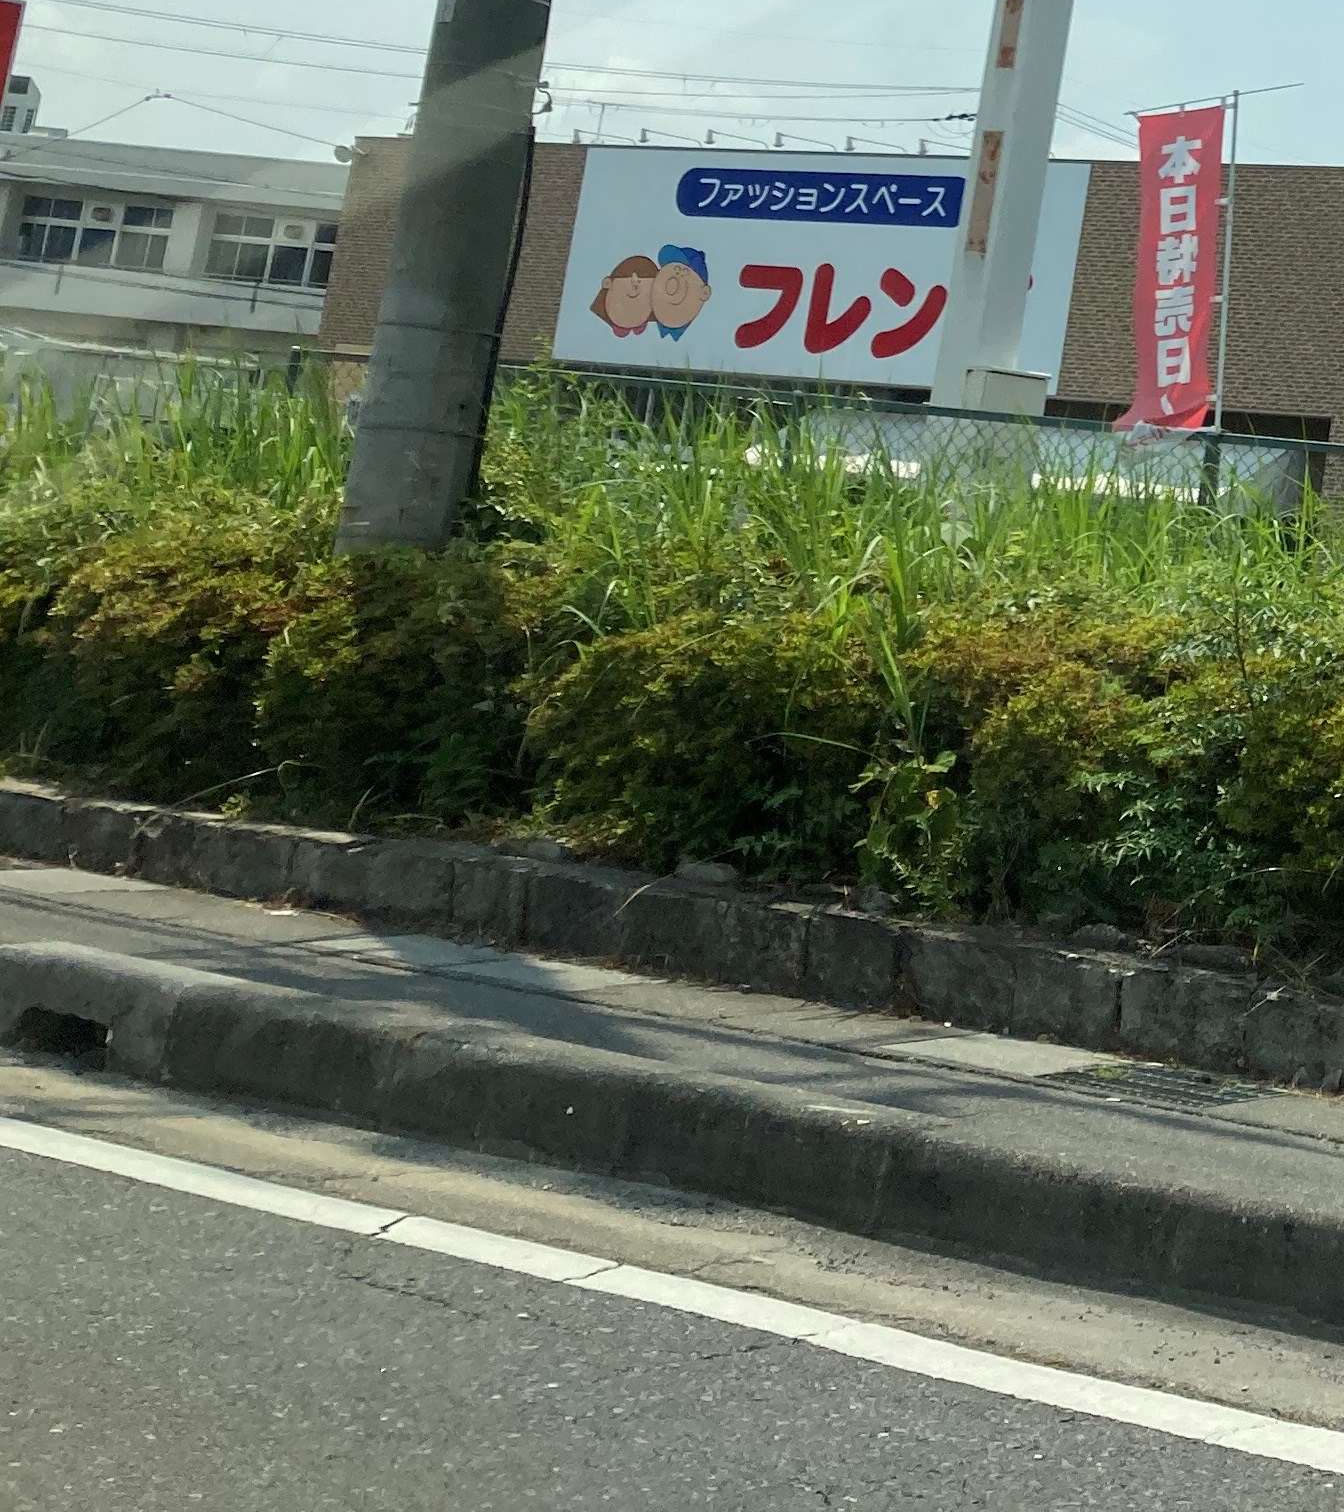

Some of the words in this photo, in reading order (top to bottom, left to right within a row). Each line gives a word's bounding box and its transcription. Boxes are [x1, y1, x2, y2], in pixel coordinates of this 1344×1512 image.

[698, 177, 947, 217] ファッションスペース
[735, 263, 949, 359] フレン
